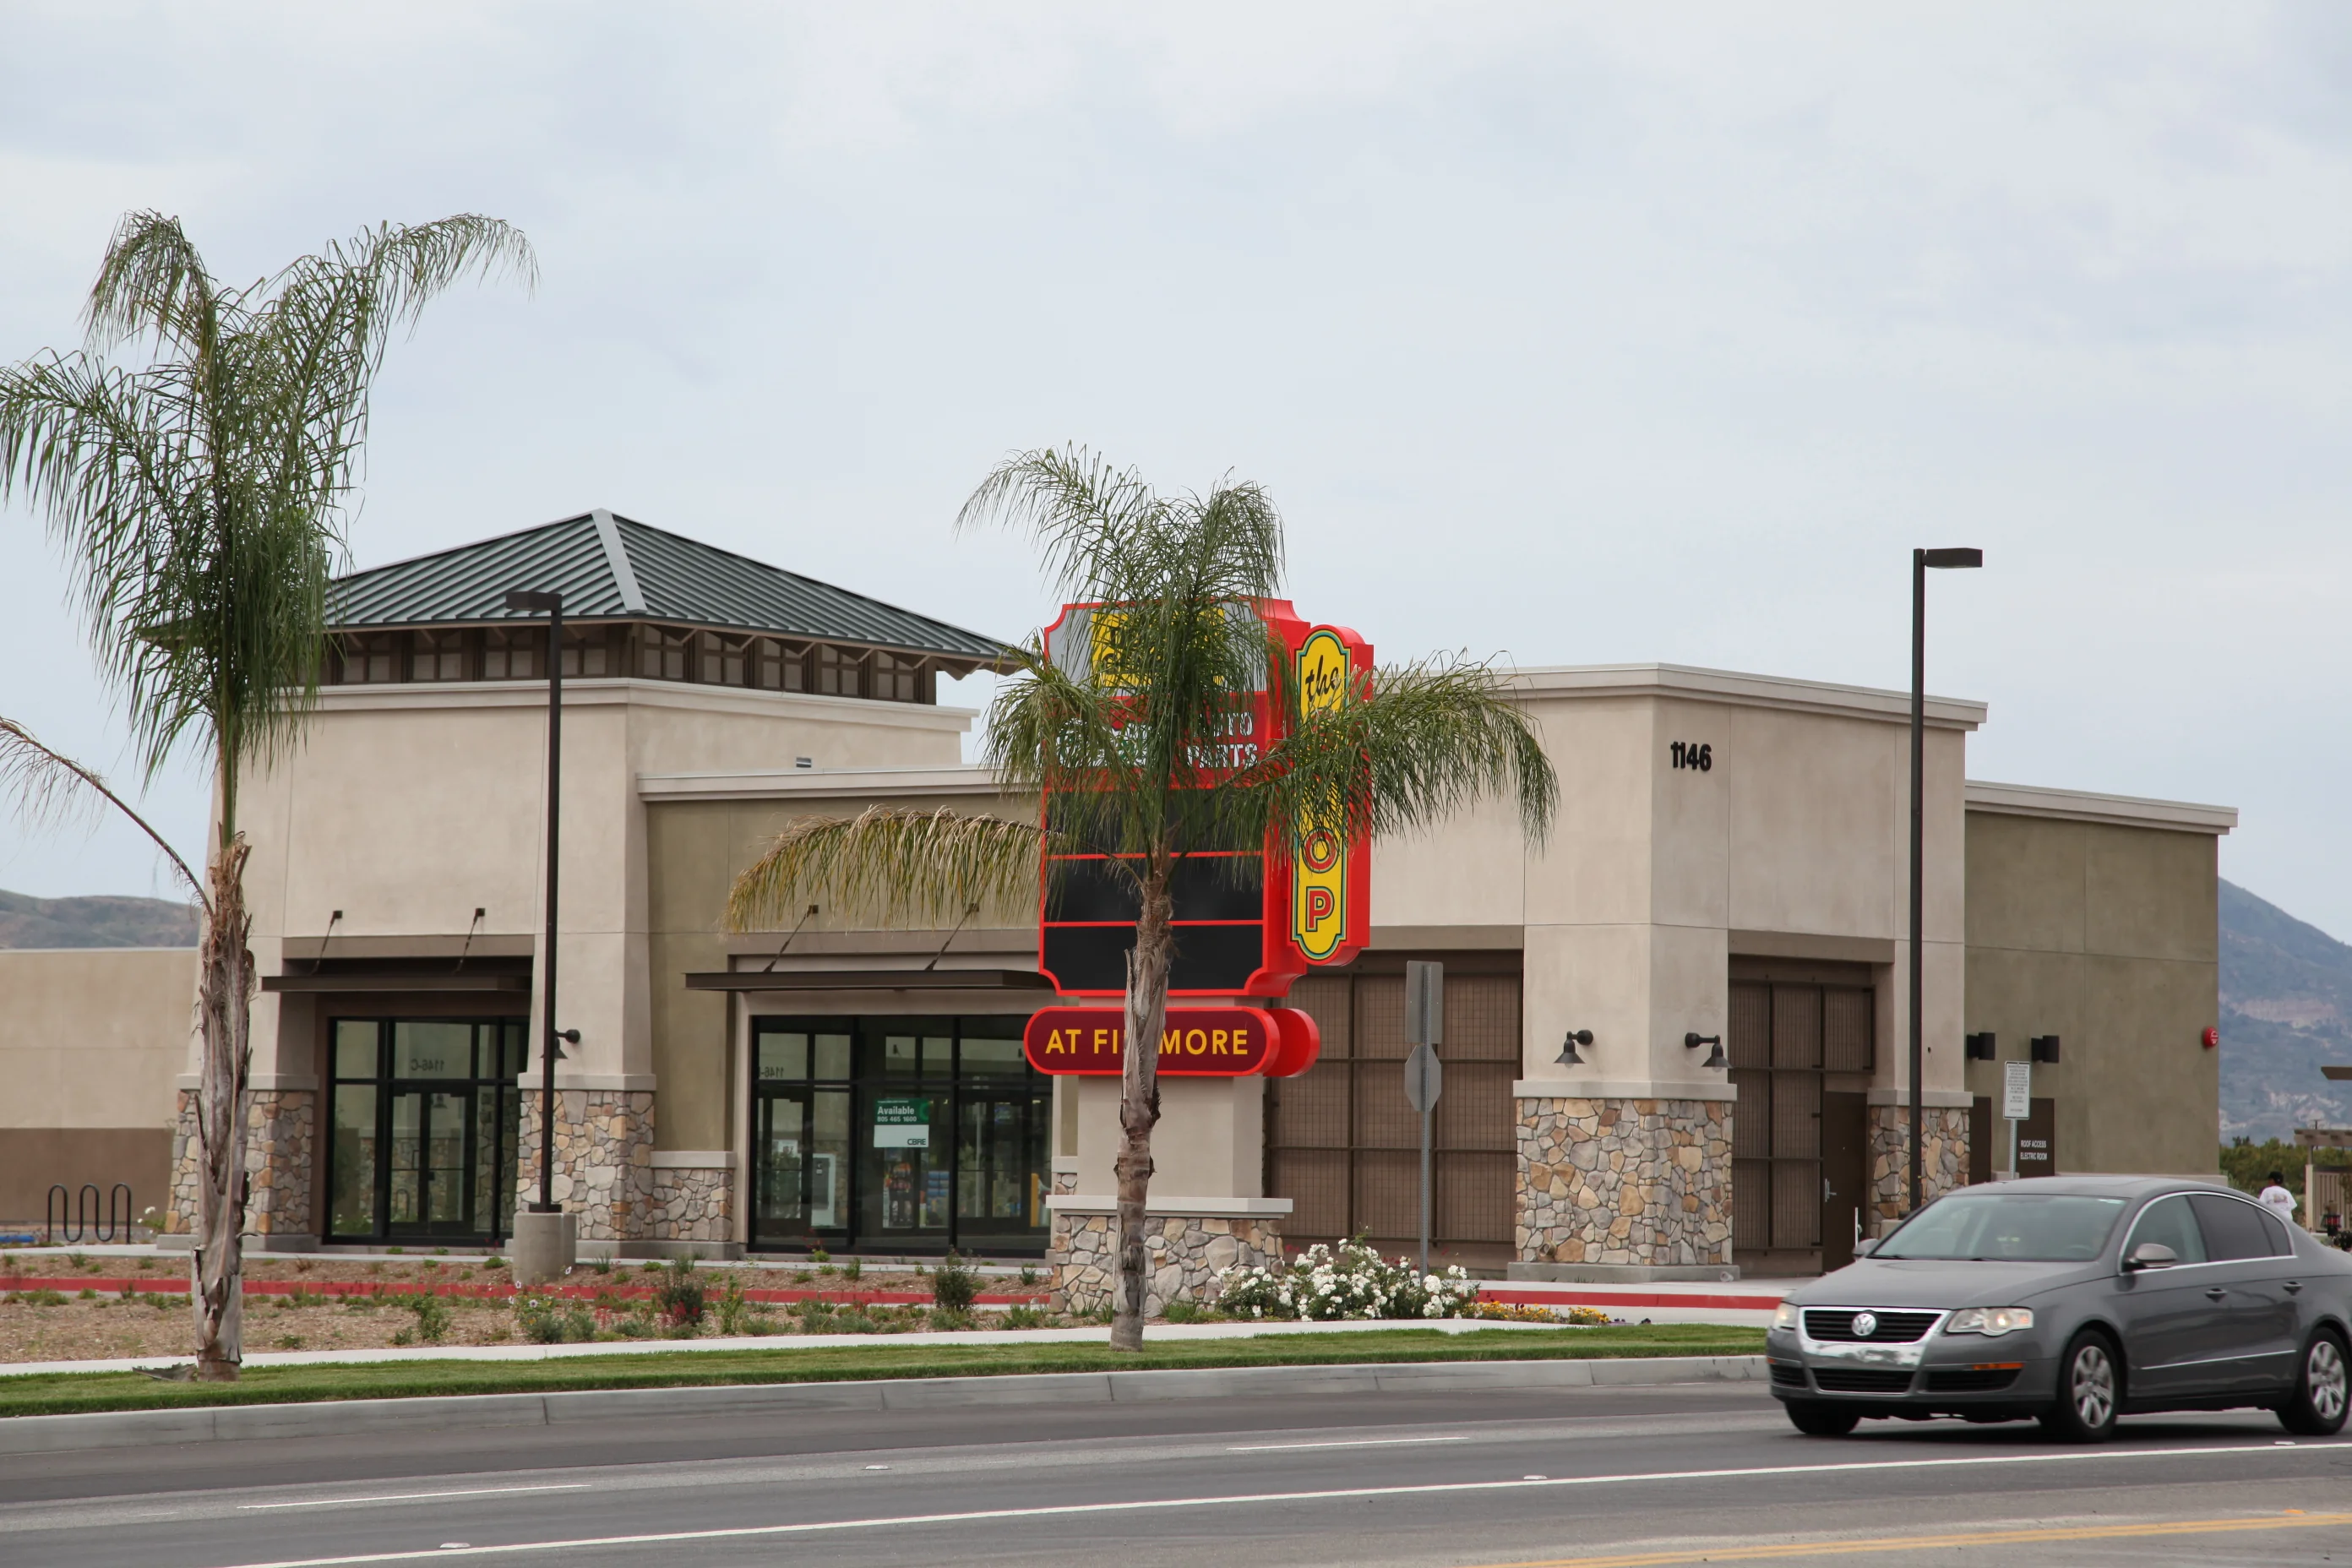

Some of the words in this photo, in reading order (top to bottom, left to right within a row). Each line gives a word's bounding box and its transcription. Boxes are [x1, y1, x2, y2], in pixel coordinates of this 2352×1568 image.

[1305, 654, 1341, 703] the
[1670, 741, 1712, 772] 1146
[1045, 1029, 1082, 1054] AT
[1093, 1028, 1249, 1055] FIMORE
[877, 1106, 915, 1115] Available
[2020, 1140, 2031, 1148] ROOF
[2032, 1141, 2046, 1149] ACCESS
